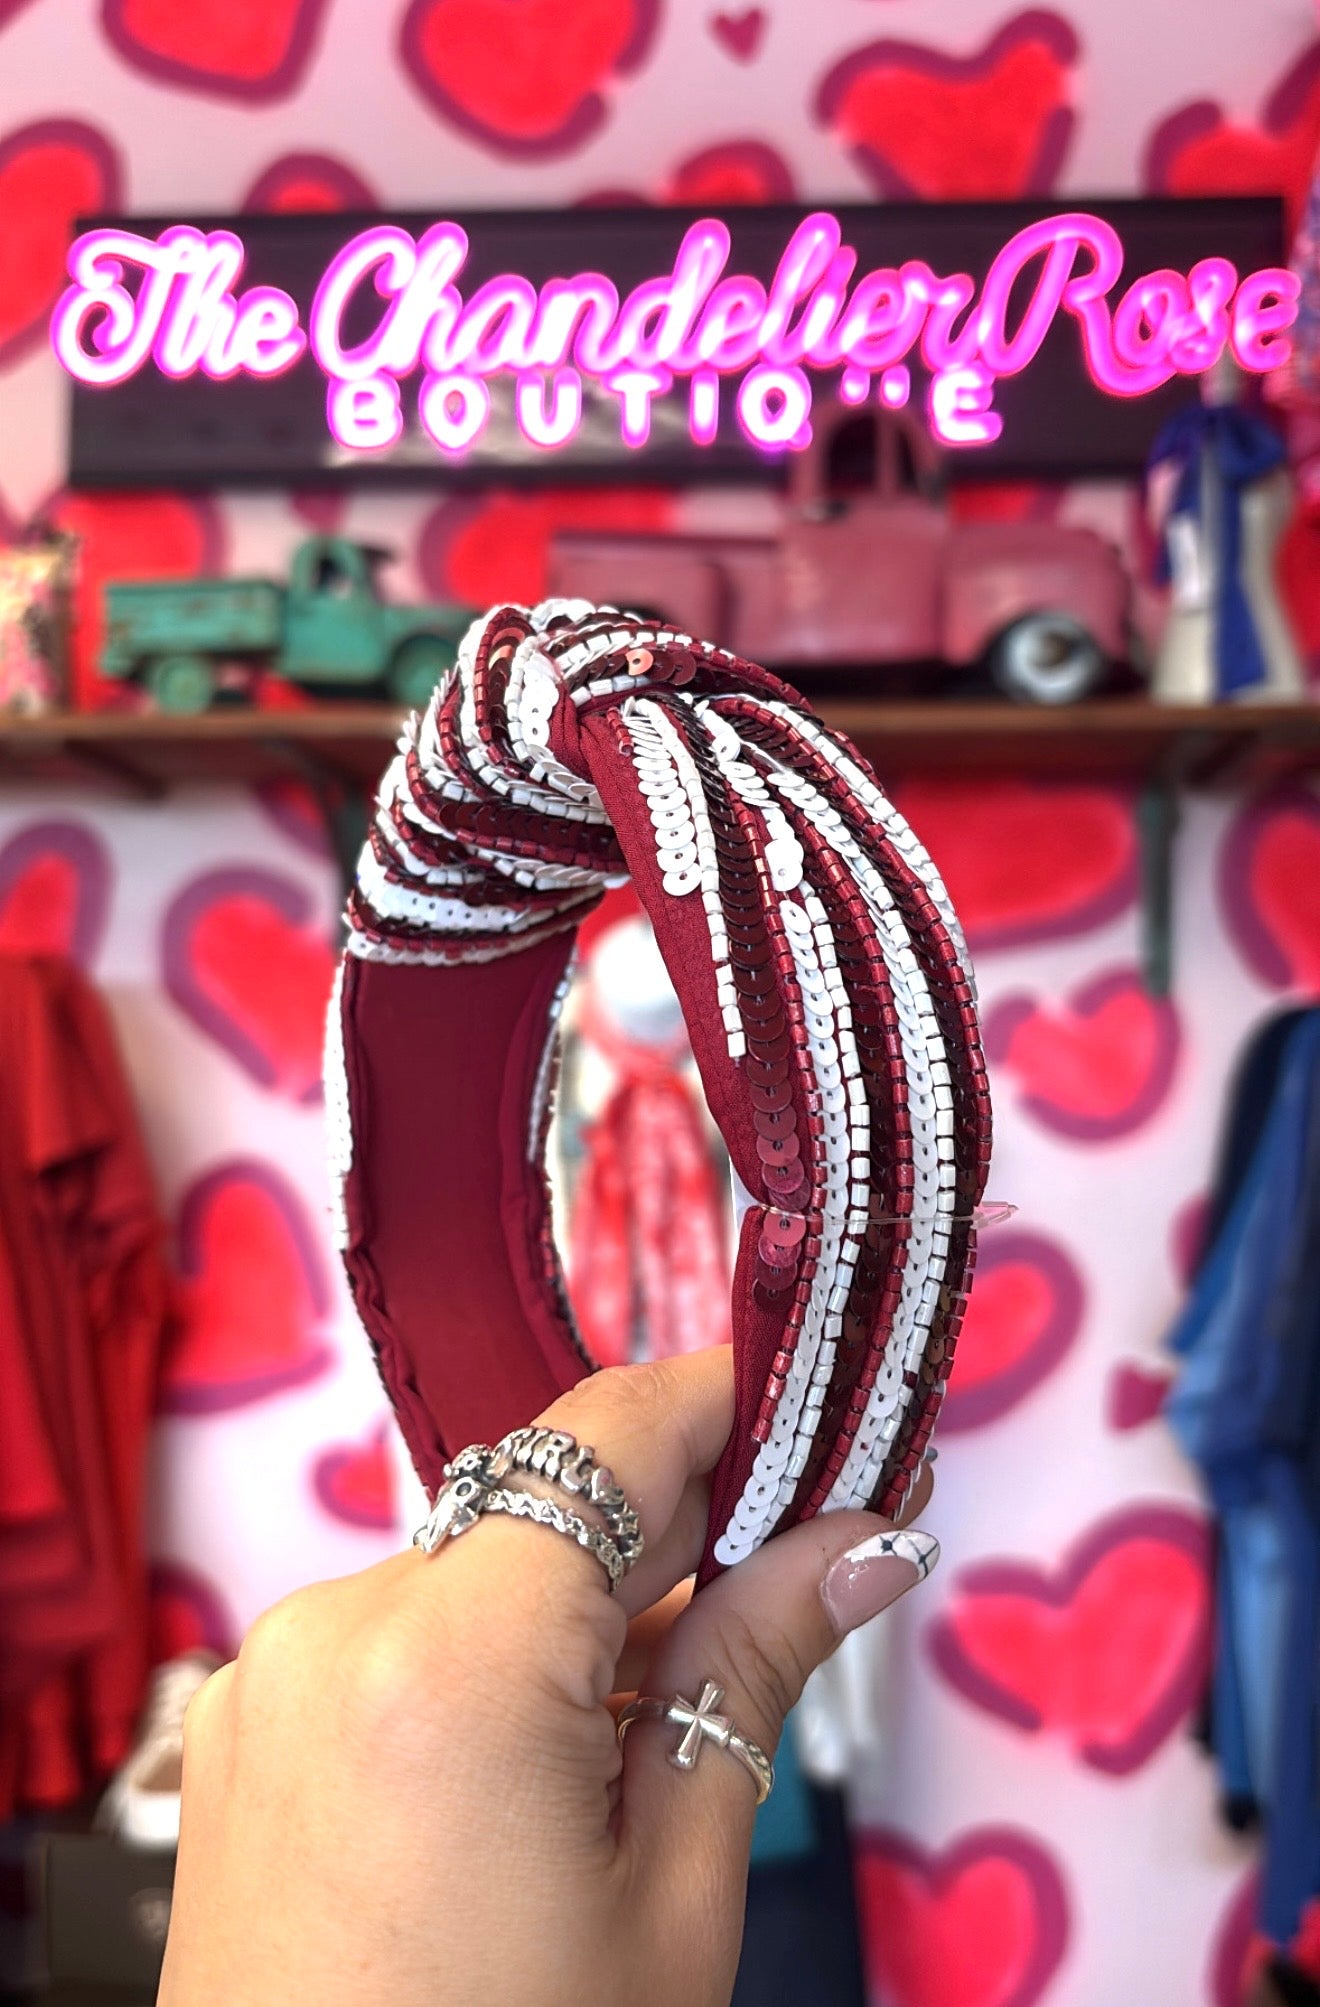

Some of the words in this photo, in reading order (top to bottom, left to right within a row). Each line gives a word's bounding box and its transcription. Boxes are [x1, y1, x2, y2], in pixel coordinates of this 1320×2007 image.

[51, 225, 307, 386] The
[310, 212, 976, 380] Chandelier
[976, 212, 1301, 398] Rose
